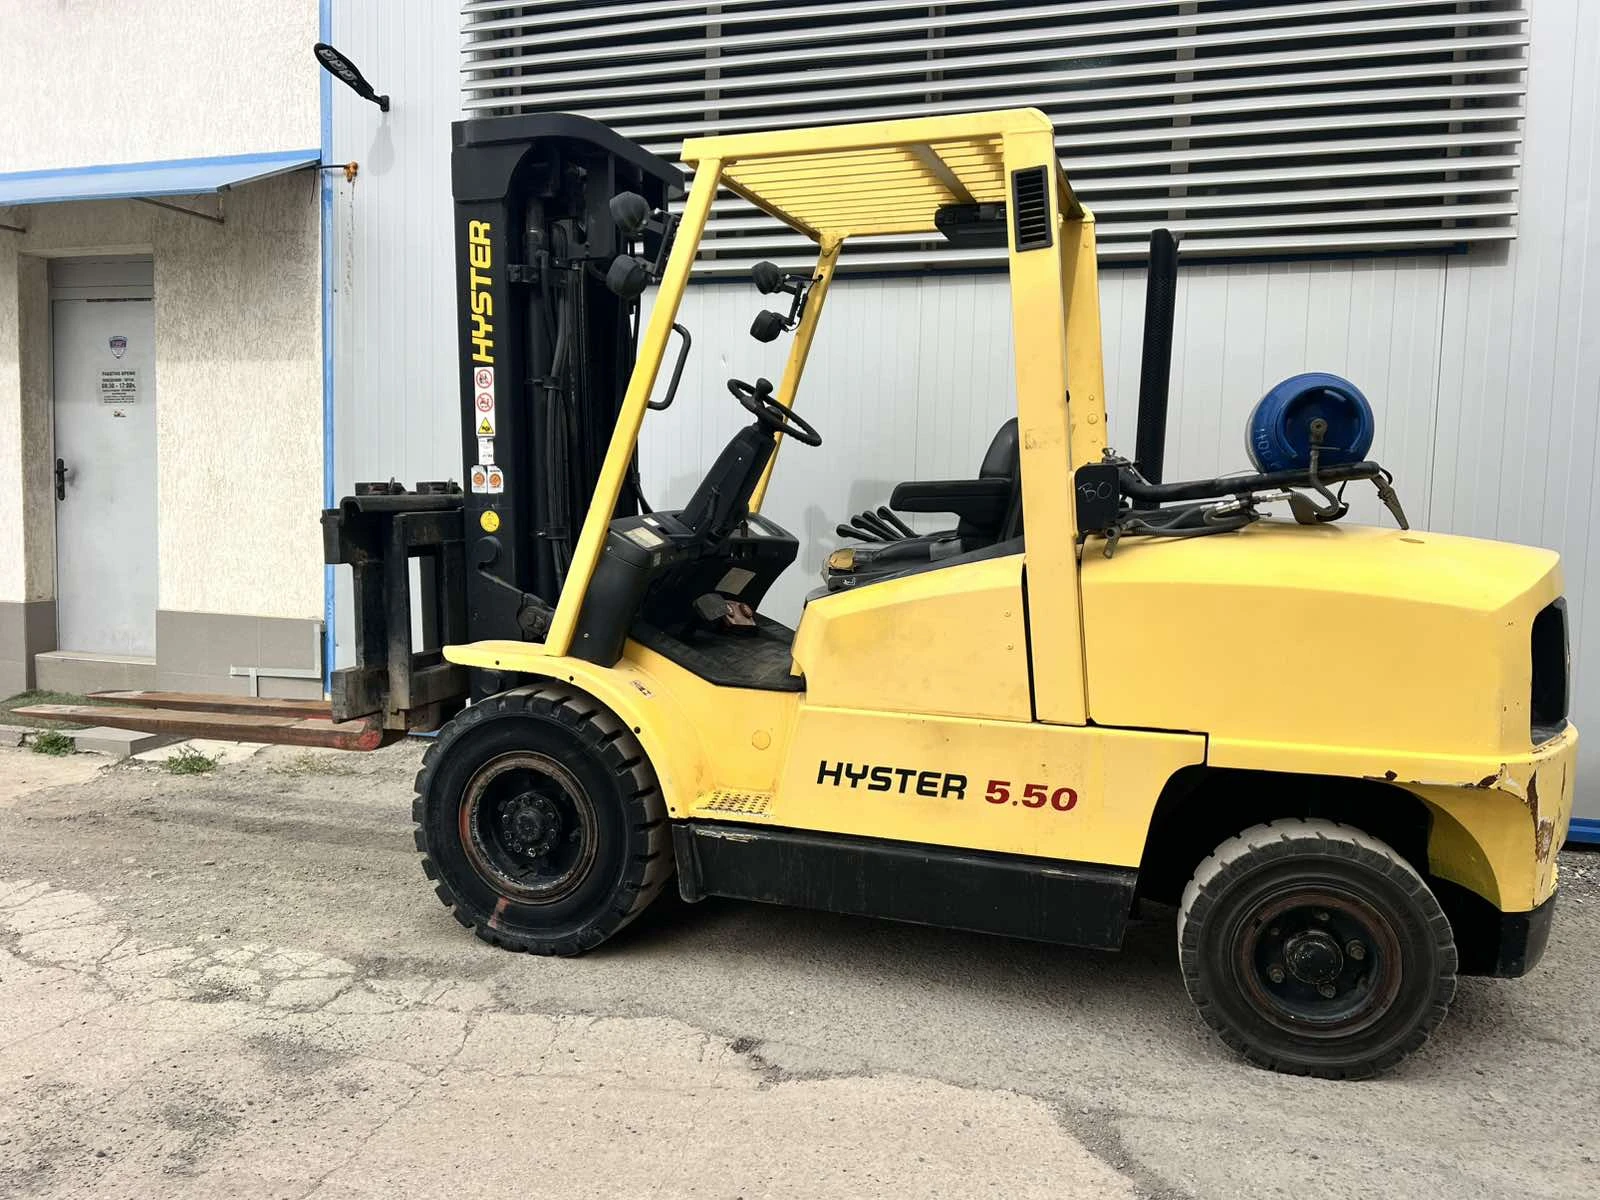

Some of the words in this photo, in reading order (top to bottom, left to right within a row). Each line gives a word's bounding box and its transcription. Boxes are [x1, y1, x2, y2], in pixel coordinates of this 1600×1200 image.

[469, 220, 494, 363] HYSTER
[816, 760, 968, 800] HYSTER
[984, 780, 1078, 812] 5.50
